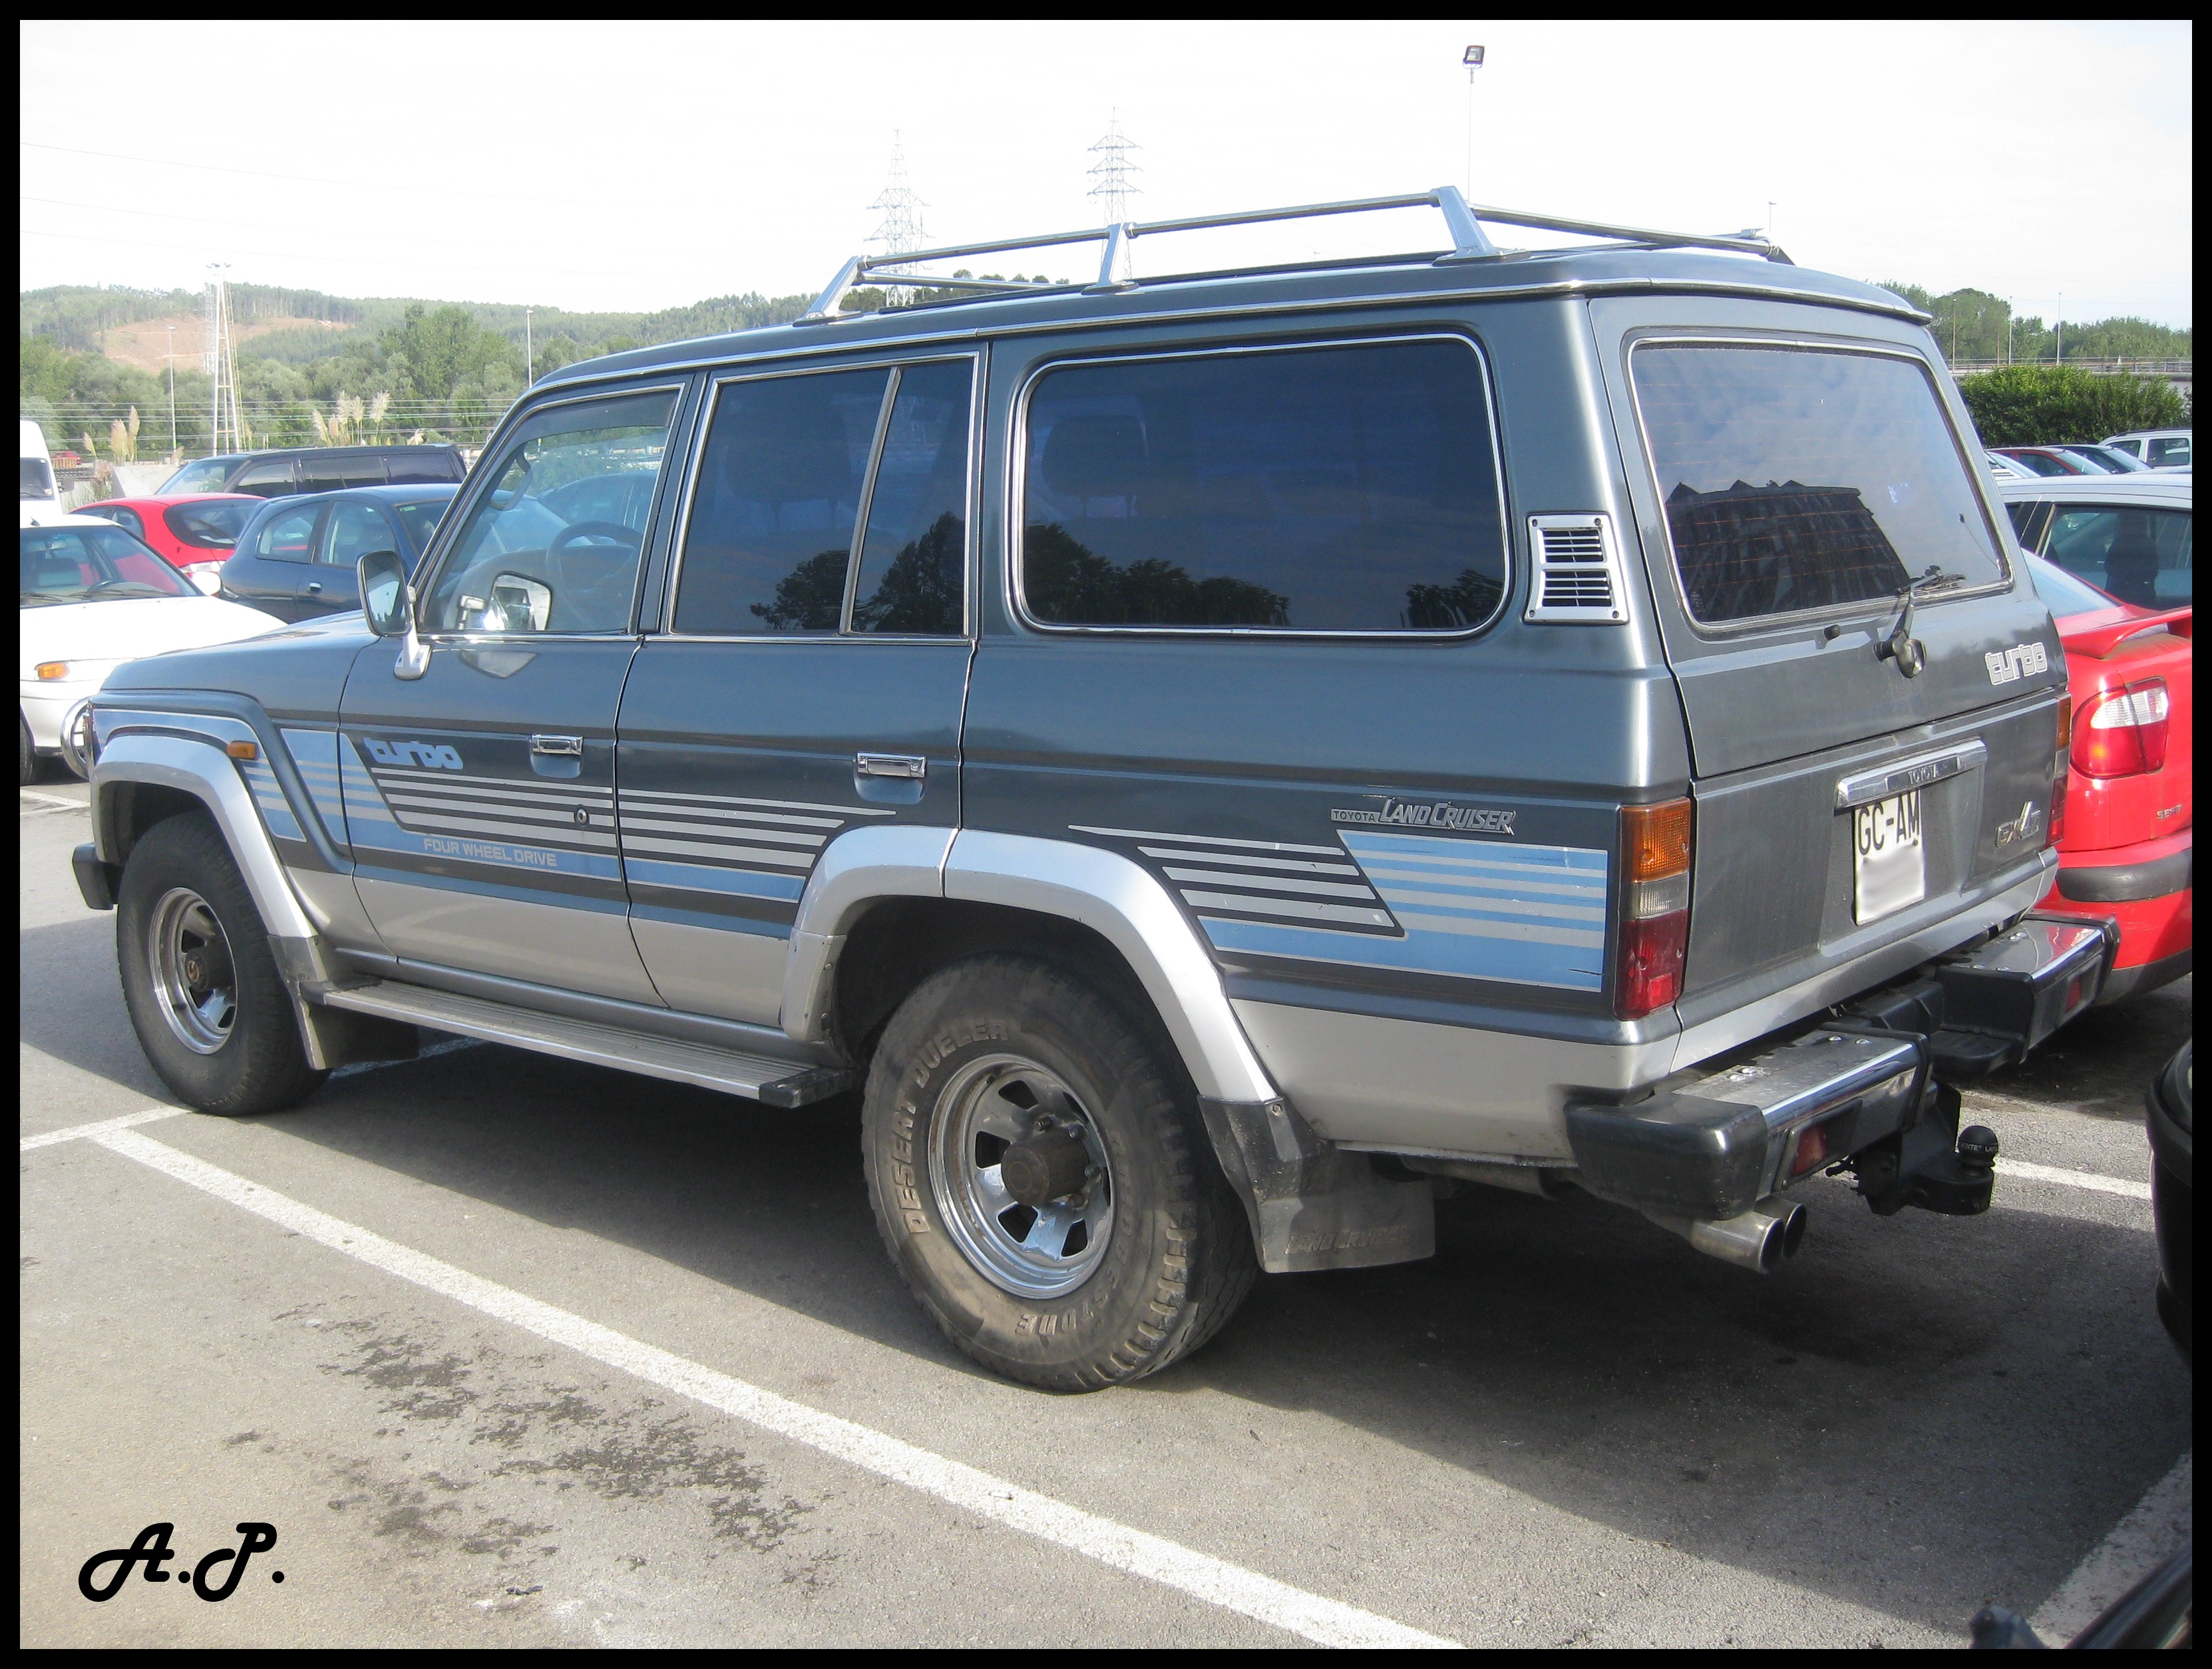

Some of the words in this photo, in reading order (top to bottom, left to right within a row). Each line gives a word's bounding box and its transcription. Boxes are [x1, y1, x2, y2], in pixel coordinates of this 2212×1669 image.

[1985, 642, 2048, 685] turbo
[363, 737, 463, 770] turbo
[1908, 763, 1941, 785] TOYOTA
[1334, 810, 1376, 823] TOYOTA
[2156, 804, 2182, 820] SEAT
[423, 838, 460, 855] FOUR
[462, 843, 512, 862] WHEEL
[513, 848, 557, 867] DRIVE
[910, 1016, 1009, 1090] DUELER
[892, 1087, 930, 1234] DESERT
